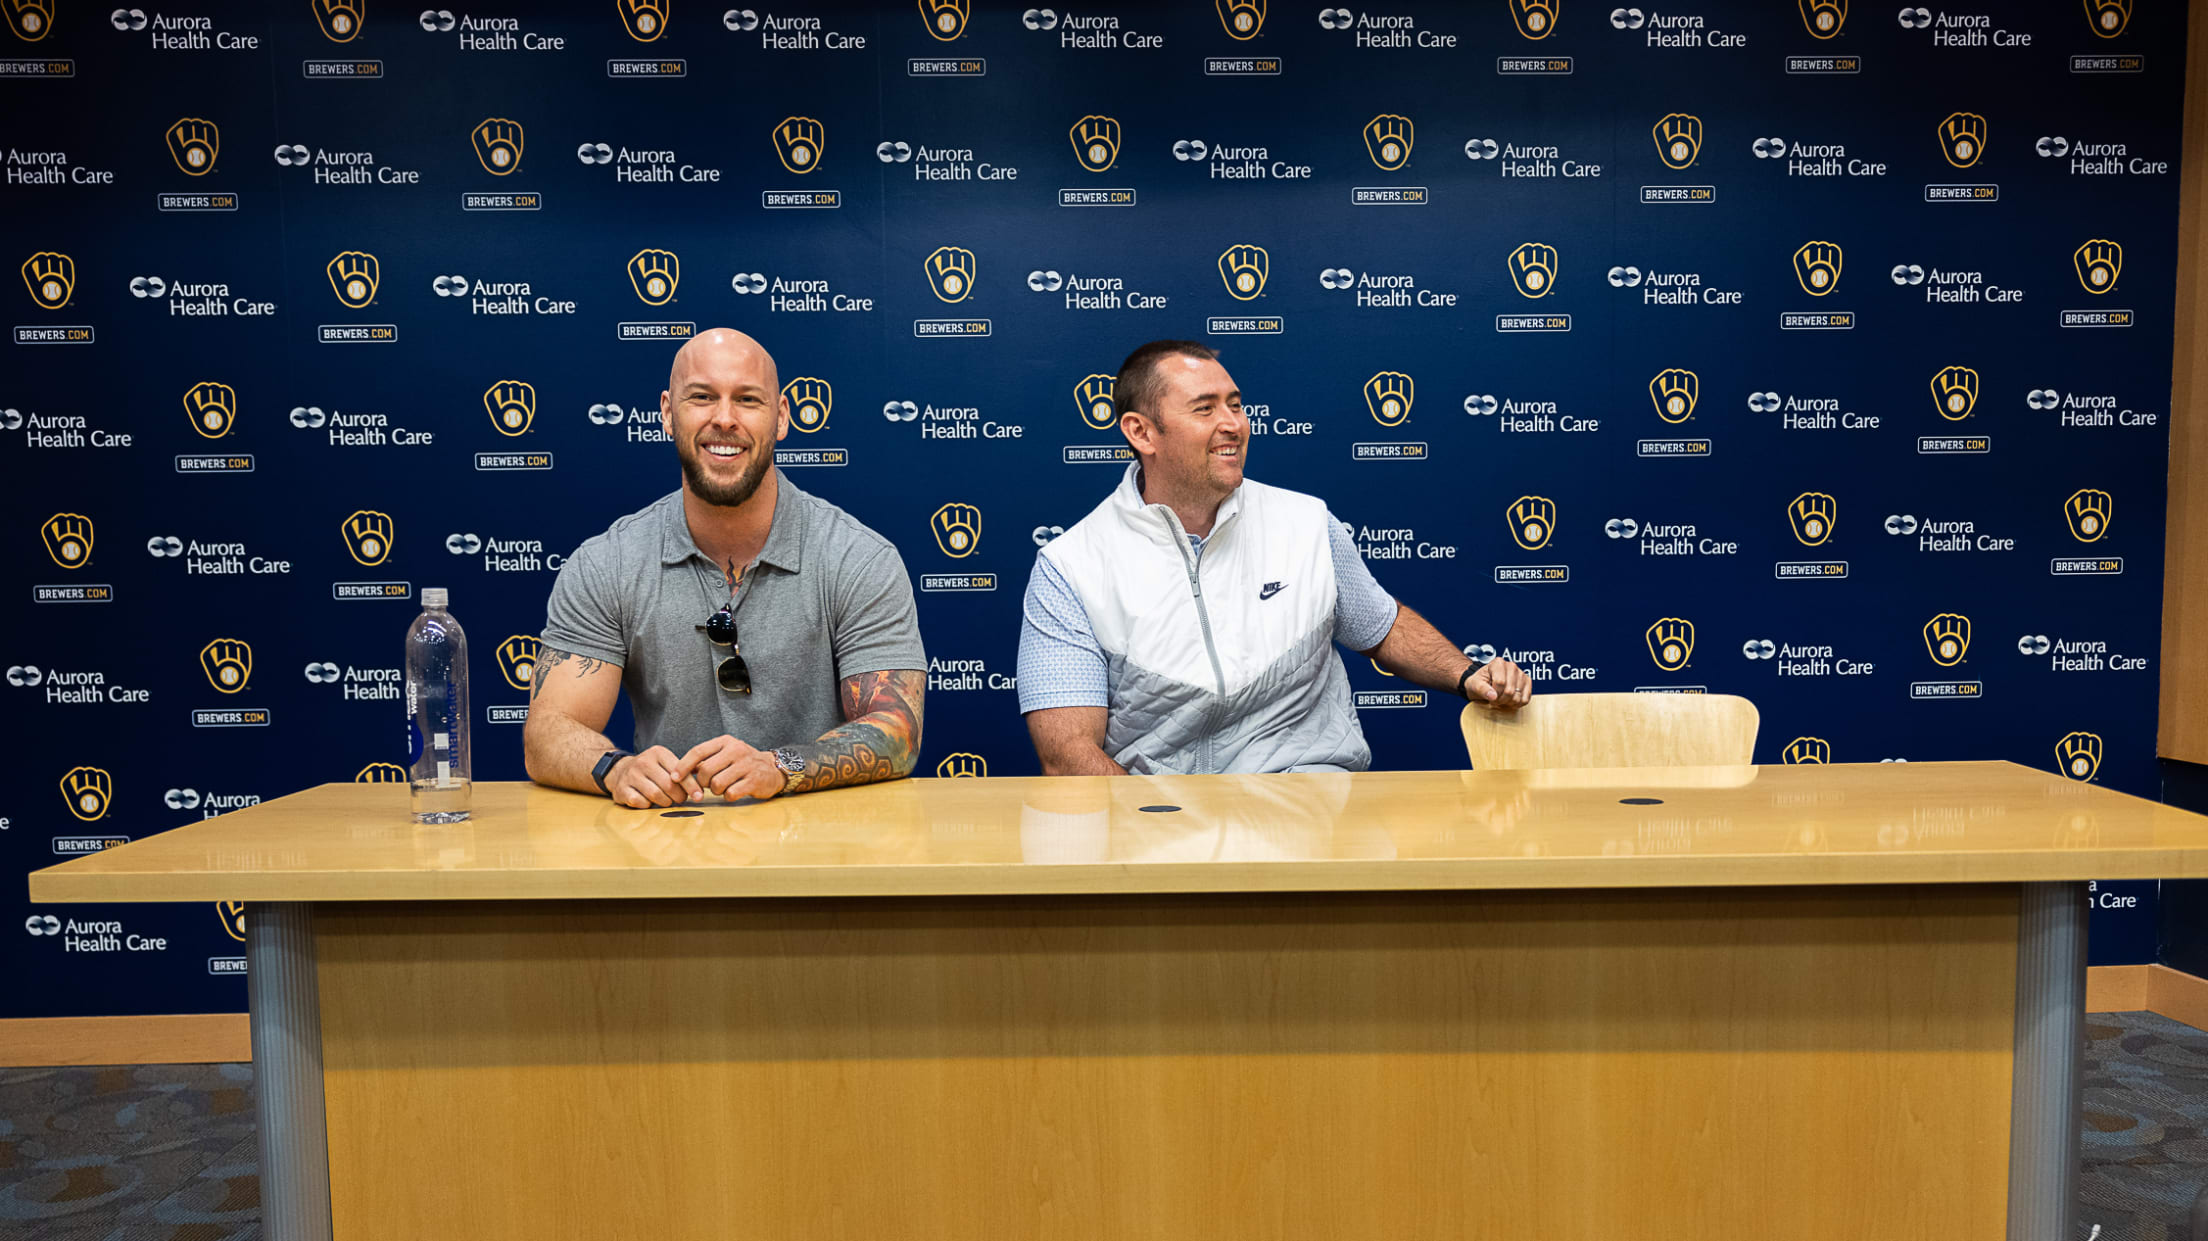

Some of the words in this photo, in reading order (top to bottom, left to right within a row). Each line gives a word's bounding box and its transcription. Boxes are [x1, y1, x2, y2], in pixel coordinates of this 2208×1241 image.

[152, 13, 211, 30] Aurora
[460, 14, 519, 31] Aurora
[763, 14, 821, 30] Aurora
[1062, 13, 1119, 29] Aurora
[1357, 13, 1413, 28] Aurora
[1648, 12, 1704, 28] Aurora
[1936, 12, 1990, 28] Aurora
[152, 31, 210, 49] Health
[217, 32, 258, 49] Care
[460, 32, 517, 50] Health
[523, 33, 564, 50] Care
[763, 31, 818, 49] Health
[825, 32, 865, 49] Care
[1062, 30, 1116, 48] Health
[1123, 31, 1163, 48] Care
[1357, 30, 1411, 47] Health
[1418, 31, 1456, 47] Care
[1648, 29, 1701, 47] Health
[1707, 31, 1746, 47] Care
[1934, 29, 1987, 46] Health
[1993, 30, 2031, 46] Care
[912, 61, 982, 73] BREWERS.COM
[1208, 60, 1277, 72] BREWERS.COM
[7, 148, 66, 165] Aurora
[618, 147, 675, 163] Aurora
[916, 145, 973, 161] Aurora
[1211, 144, 1268, 160] Aurora
[1503, 143, 1558, 158] Aurora
[1790, 142, 1845, 157] Aurora
[2072, 141, 2126, 156] Aurora
[315, 149, 373, 165] Aurora
[617, 164, 673, 182] Health
[680, 165, 720, 182] Care
[916, 162, 971, 180] Health
[977, 163, 1017, 180] Care
[1211, 161, 1265, 178] Health
[1272, 162, 1311, 178] Care
[1502, 160, 1555, 177] Health
[1562, 161, 1600, 177] Care
[1789, 158, 1842, 176] Health
[1848, 159, 1886, 176] Care
[2071, 157, 2123, 174] Health
[2129, 158, 2167, 174] Care
[7, 166, 65, 184] Health
[72, 167, 113, 184] Care
[315, 166, 372, 184] Health
[378, 167, 419, 183] Care
[766, 193, 837, 206] BREWERS.COM
[1063, 191, 1132, 203] BREWERS.COM
[1356, 190, 1424, 202] BREWERS.COM
[1644, 189, 1711, 200] BREWERS.COM
[1929, 187, 1995, 199] BREWERS.COM
[162, 196, 234, 208] BREWERS.COM
[466, 195, 537, 208] BREWERS.COM
[1066, 275, 1123, 290] Aurora
[1358, 272, 1414, 288] Aurora
[1645, 270, 1700, 286] Aurora
[1928, 268, 1982, 284] Aurora
[170, 280, 229, 296] Aurora
[473, 279, 531, 295] Aurora
[771, 277, 829, 293] Aurora
[1066, 291, 1120, 309] Health
[1127, 292, 1166, 308] Care
[1358, 289, 1411, 306] Health
[1417, 290, 1456, 306] Care
[1645, 287, 1697, 304] Health
[1703, 288, 1741, 304] Care
[1927, 285, 1979, 302] Health
[1985, 286, 2022, 302] Care
[170, 298, 227, 315] Health
[234, 298, 274, 315] Care
[473, 296, 529, 314] Health
[535, 297, 575, 314] Care
[771, 294, 826, 311] Health
[833, 295, 872, 311] Care
[1211, 319, 1279, 331] BREWERS.COM
[1500, 317, 1567, 329] BREWERS.COM
[1785, 315, 1851, 326] BREWERS.COM
[2064, 313, 2129, 324] BREWERS.COM
[18, 329, 90, 341] BREWERS.COM
[322, 327, 393, 340] BREWERS.COM
[622, 325, 692, 337] BREWERS.COM
[918, 322, 988, 334] BREWERS.COM
[1501, 399, 1557, 414] Aurora
[1785, 395, 1839, 411] Aurora
[2063, 393, 2116, 408] Aurora
[330, 411, 388, 427] Aurora
[922, 404, 979, 420] Aurora
[2062, 409, 2113, 426] Health
[2119, 410, 2156, 425] Care
[27, 413, 86, 428] Aurora
[1501, 415, 1554, 432] Health
[1560, 416, 1598, 431] Care
[1784, 412, 1836, 429] Health
[1842, 413, 1879, 428] Care
[330, 428, 386, 445] Health
[392, 428, 432, 445] Care
[922, 421, 977, 438] Health
[983, 422, 1022, 438] Care
[27, 429, 84, 447] Health
[91, 430, 131, 447] Care
[1922, 439, 1986, 451] BREWERS.COM
[1356, 445, 1424, 457] BREWERS.COM
[1641, 442, 1707, 454] BREWERS.COM
[179, 457, 250, 470] BREWERS.COM
[479, 455, 549, 467] BREWERS.COM
[776, 452, 843, 464] BREWERS.COM
[1358, 526, 1414, 541] Aurora
[1642, 522, 1696, 537] Aurora
[1921, 518, 1974, 533] Aurora
[187, 540, 245, 556] Aurora
[485, 537, 543, 553] Aurora
[1417, 542, 1455, 558] Care
[1641, 538, 1693, 555] Health
[1699, 539, 1737, 554] Care
[1920, 534, 1971, 551] Health
[1977, 535, 2014, 551] Care
[187, 556, 244, 574] Health
[250, 557, 290, 573] Care
[485, 553, 541, 571] Health
[1779, 564, 1844, 576] BREWERS.COM
[2055, 560, 2119, 572] BREWERS.COM
[1499, 568, 1565, 580] BREWERS.COM
[925, 576, 993, 589] BREWERS.COM
[1263, 581, 1281, 592] NIKE
[37, 587, 109, 600] BREWERS.COM
[337, 585, 407, 597] BREWERS.COM
[1779, 643, 1833, 658] Aurora
[2053, 638, 2106, 653] Aurora
[928, 656, 985, 672] Aurora
[1779, 658, 1830, 675] Health
[1836, 659, 1873, 675] Care
[2053, 654, 2103, 671] Health
[2109, 655, 2146, 670] Care
[47, 669, 105, 685] Aurora
[344, 666, 402, 681] Aurora
[1558, 664, 1595, 680] Care
[928, 673, 983, 690] Health
[47, 686, 104, 703] Health
[109, 686, 149, 702] Care
[344, 682, 400, 700] Health
[1914, 684, 1978, 696] BREWERS.COM
[1357, 694, 1423, 705] BREWERS.COM
[196, 712, 266, 724] BREWERS.COM
[2100, 893, 2136, 908] Care
[65, 919, 122, 934] Aurora
[65, 935, 121, 952] Health
[126, 935, 166, 951] Care
